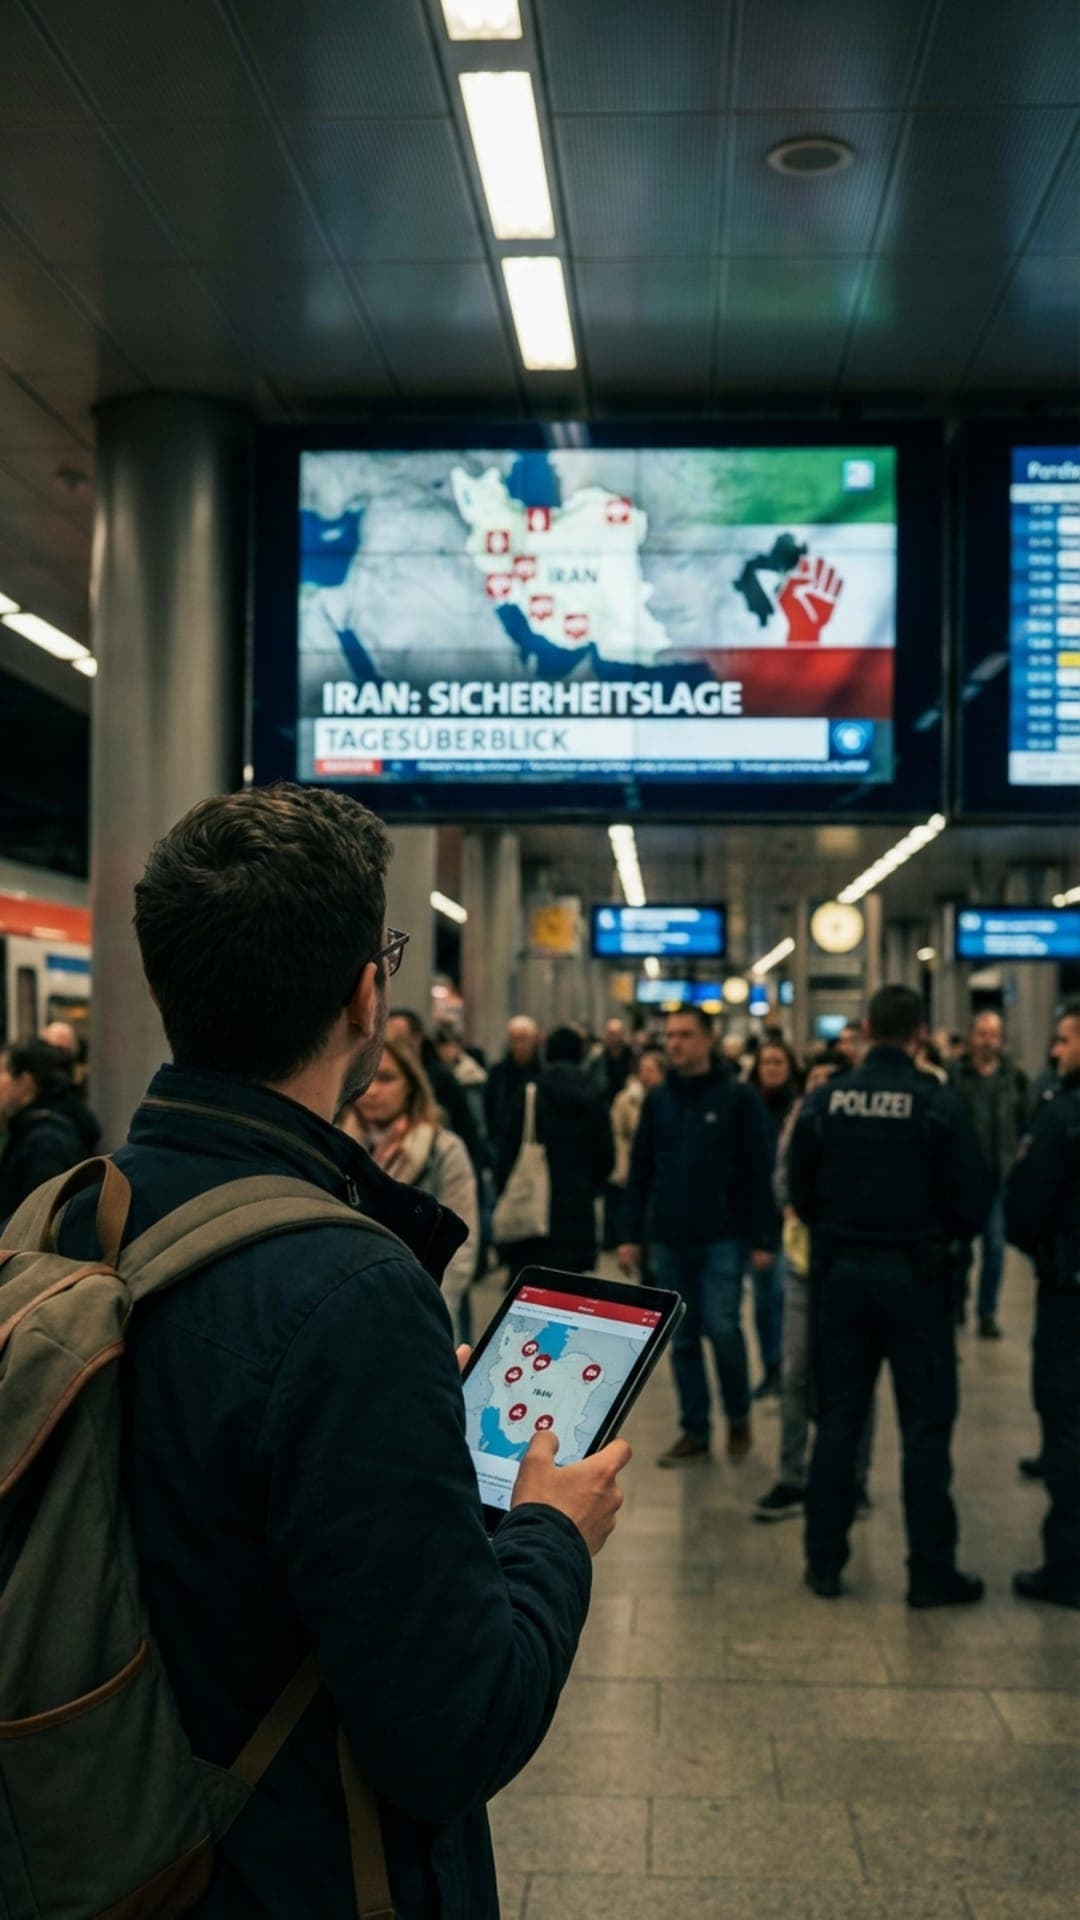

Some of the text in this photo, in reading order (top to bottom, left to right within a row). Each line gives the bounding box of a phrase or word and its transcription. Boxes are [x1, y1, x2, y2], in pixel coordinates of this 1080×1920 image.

[548, 567, 598, 585] IRAN
[323, 681, 742, 715] IRAN: SICHERHEITSLAGE
[327, 727, 568, 751] TAGESÜBERBLICK
[829, 1090, 913, 1118] POLIZEI
